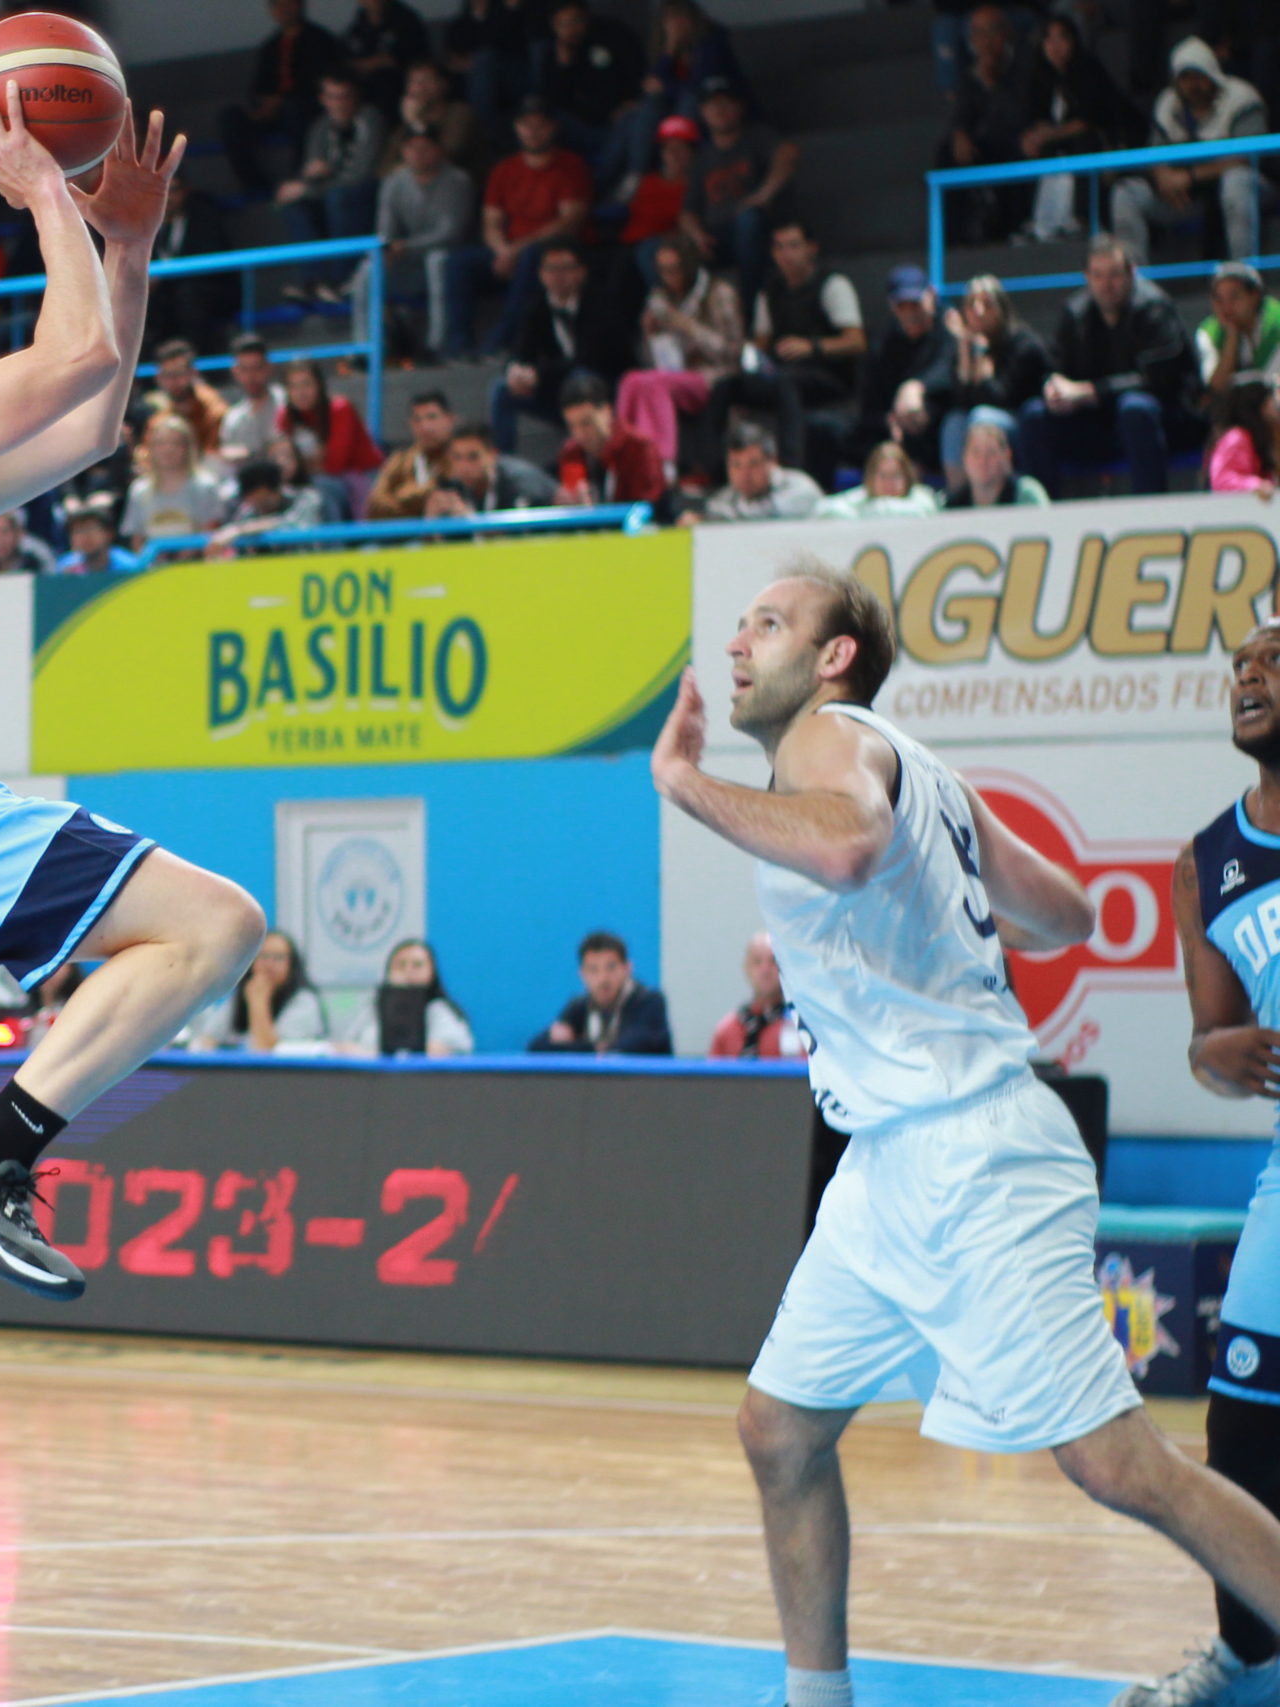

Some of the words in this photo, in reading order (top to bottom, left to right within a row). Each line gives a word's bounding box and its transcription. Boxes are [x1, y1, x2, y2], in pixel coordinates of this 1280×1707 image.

[20, 85, 92, 103] molten
[301, 568, 393, 620] DON
[853, 523, 1280, 665] GUER
[208, 614, 488, 730] BASILIO
[894, 671, 1160, 718] COMPENSADOS
[268, 726, 344, 752] YERBA
[356, 721, 421, 750] MATE
